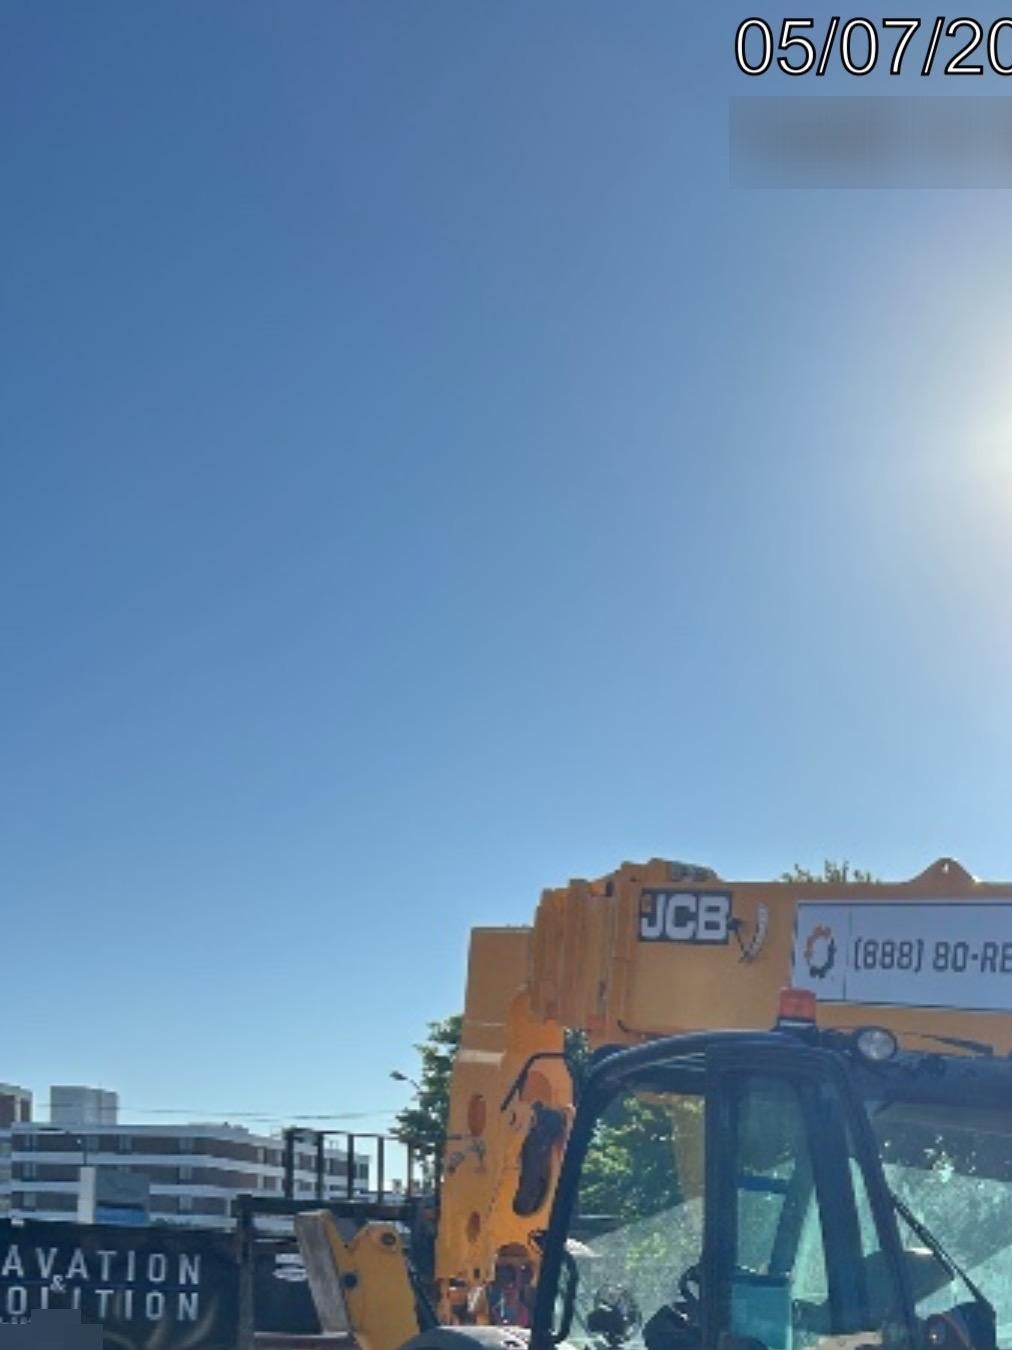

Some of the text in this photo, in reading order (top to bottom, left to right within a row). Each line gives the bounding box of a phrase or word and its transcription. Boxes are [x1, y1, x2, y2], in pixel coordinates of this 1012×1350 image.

[640, 892, 730, 942] JCB
[1, 1243, 201, 1286] AVATION
[49, 1274, 66, 1294] &
